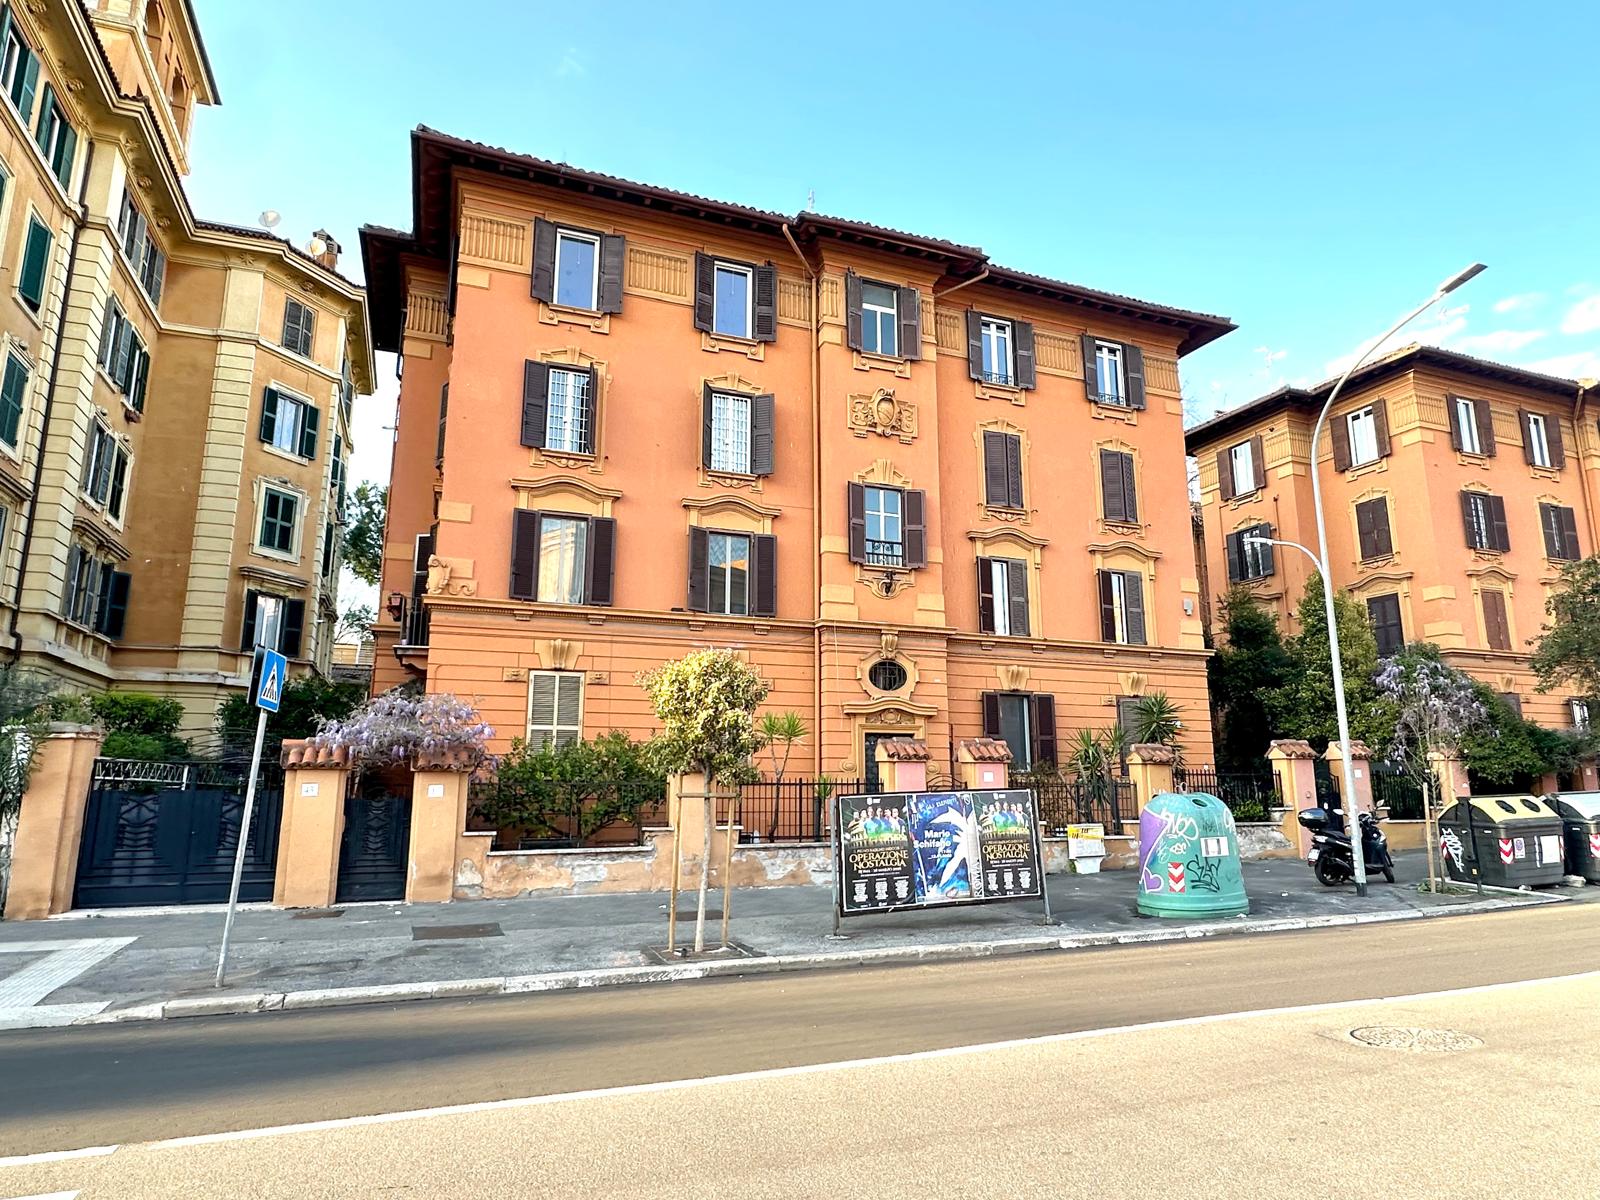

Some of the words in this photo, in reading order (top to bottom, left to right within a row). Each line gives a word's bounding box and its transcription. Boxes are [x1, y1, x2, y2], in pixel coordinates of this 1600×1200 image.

[924, 829, 950, 839] Mario
[982, 842, 1030, 854] OPERAZIONE
[849, 849, 909, 863] OPERAZIONE
[986, 850, 1028, 861] NOSTALGIA
[853, 858, 906, 871] NOSTALGIA
[974, 861, 982, 897] ROMA
